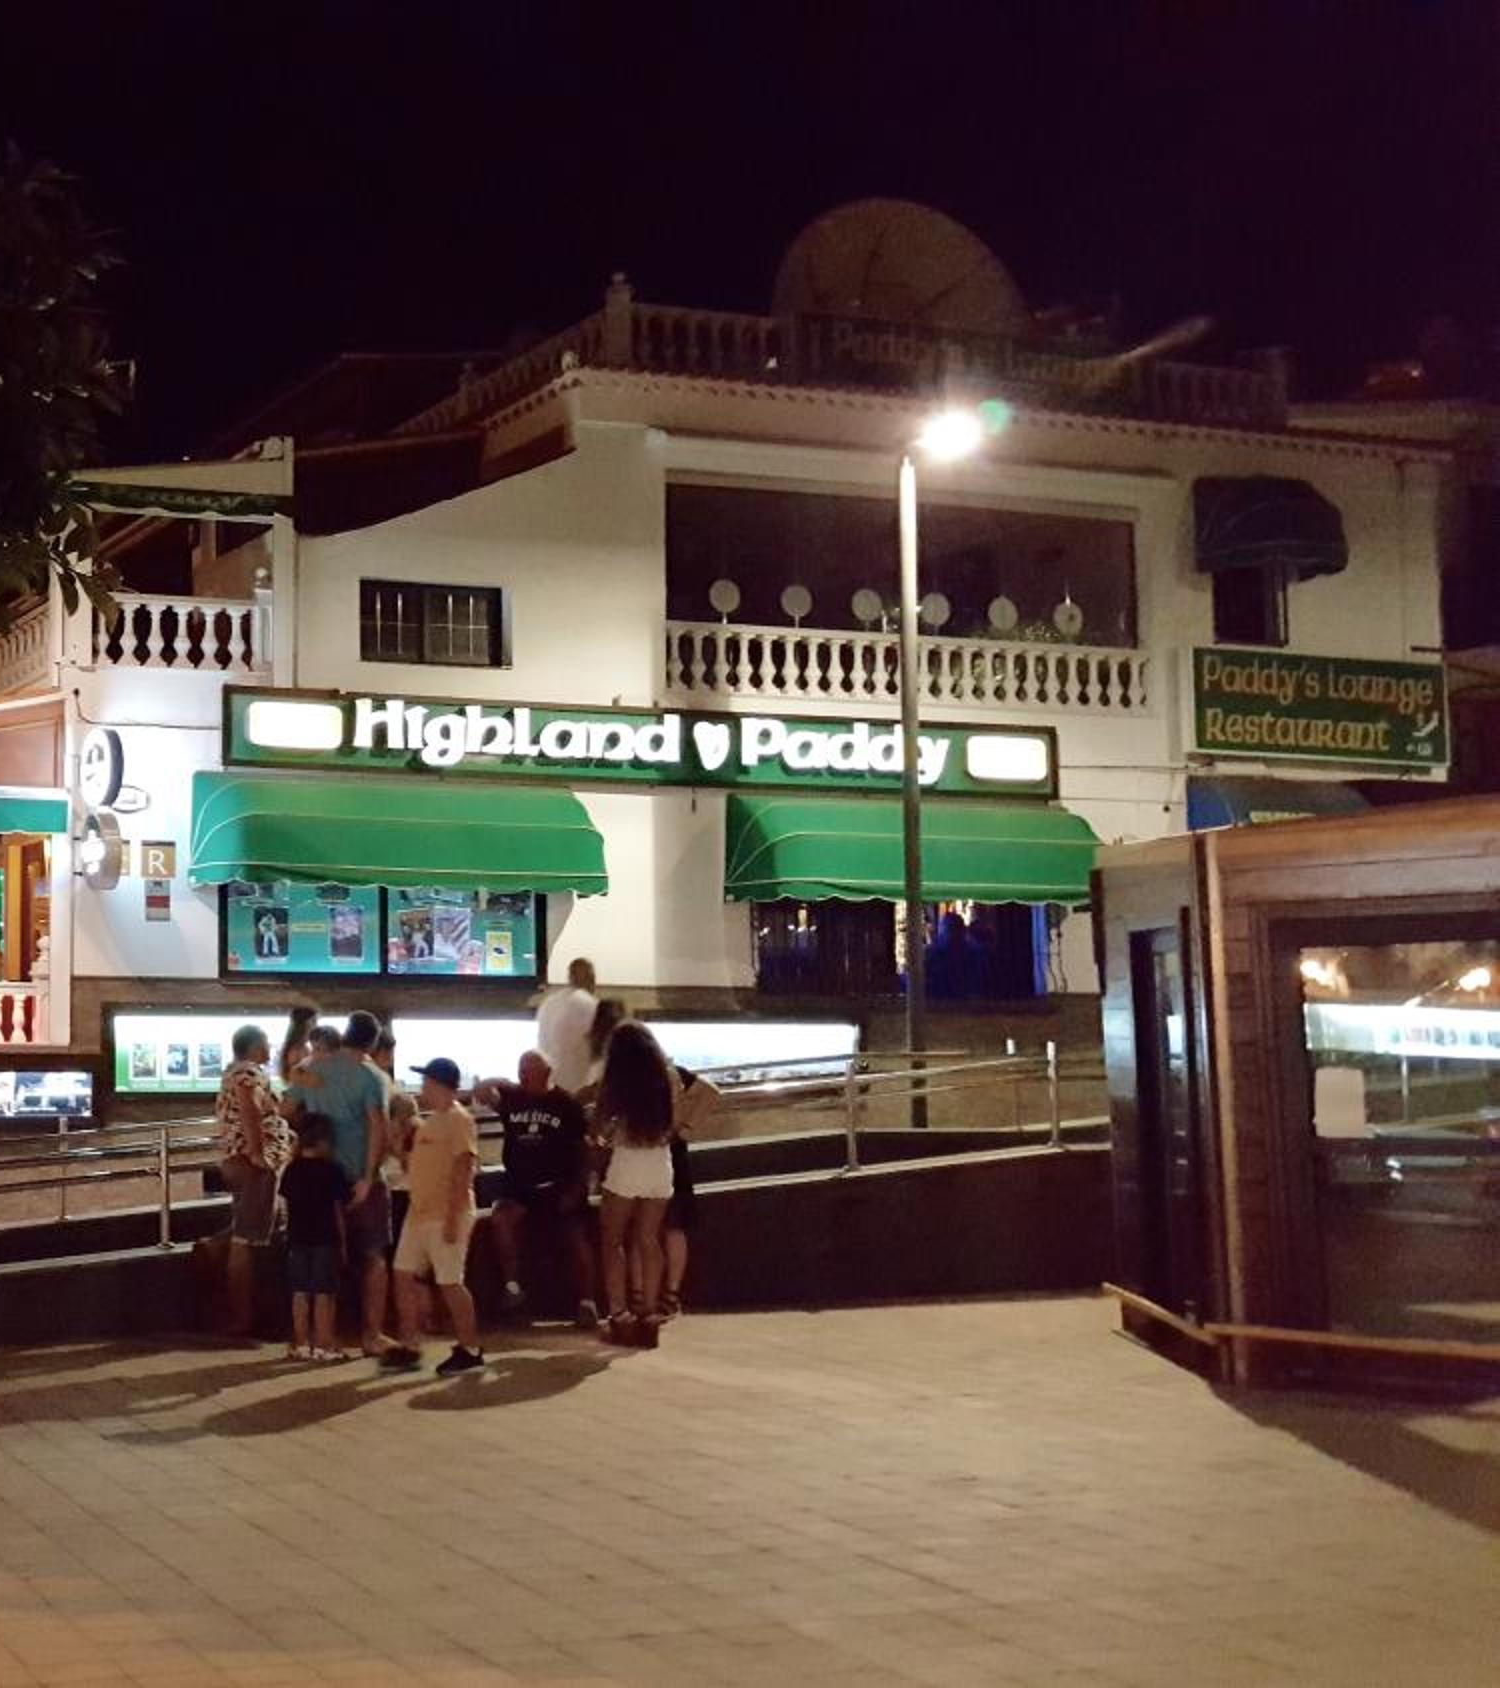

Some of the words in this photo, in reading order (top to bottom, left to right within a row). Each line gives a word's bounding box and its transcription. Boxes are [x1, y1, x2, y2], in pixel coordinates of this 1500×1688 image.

[1202, 654, 1320, 705] Paddy's
[1328, 663, 1434, 715] Lounge
[740, 717, 950, 785] Paddy
[1204, 706, 1390, 751] Restaurant
[148, 849, 168, 875] R
